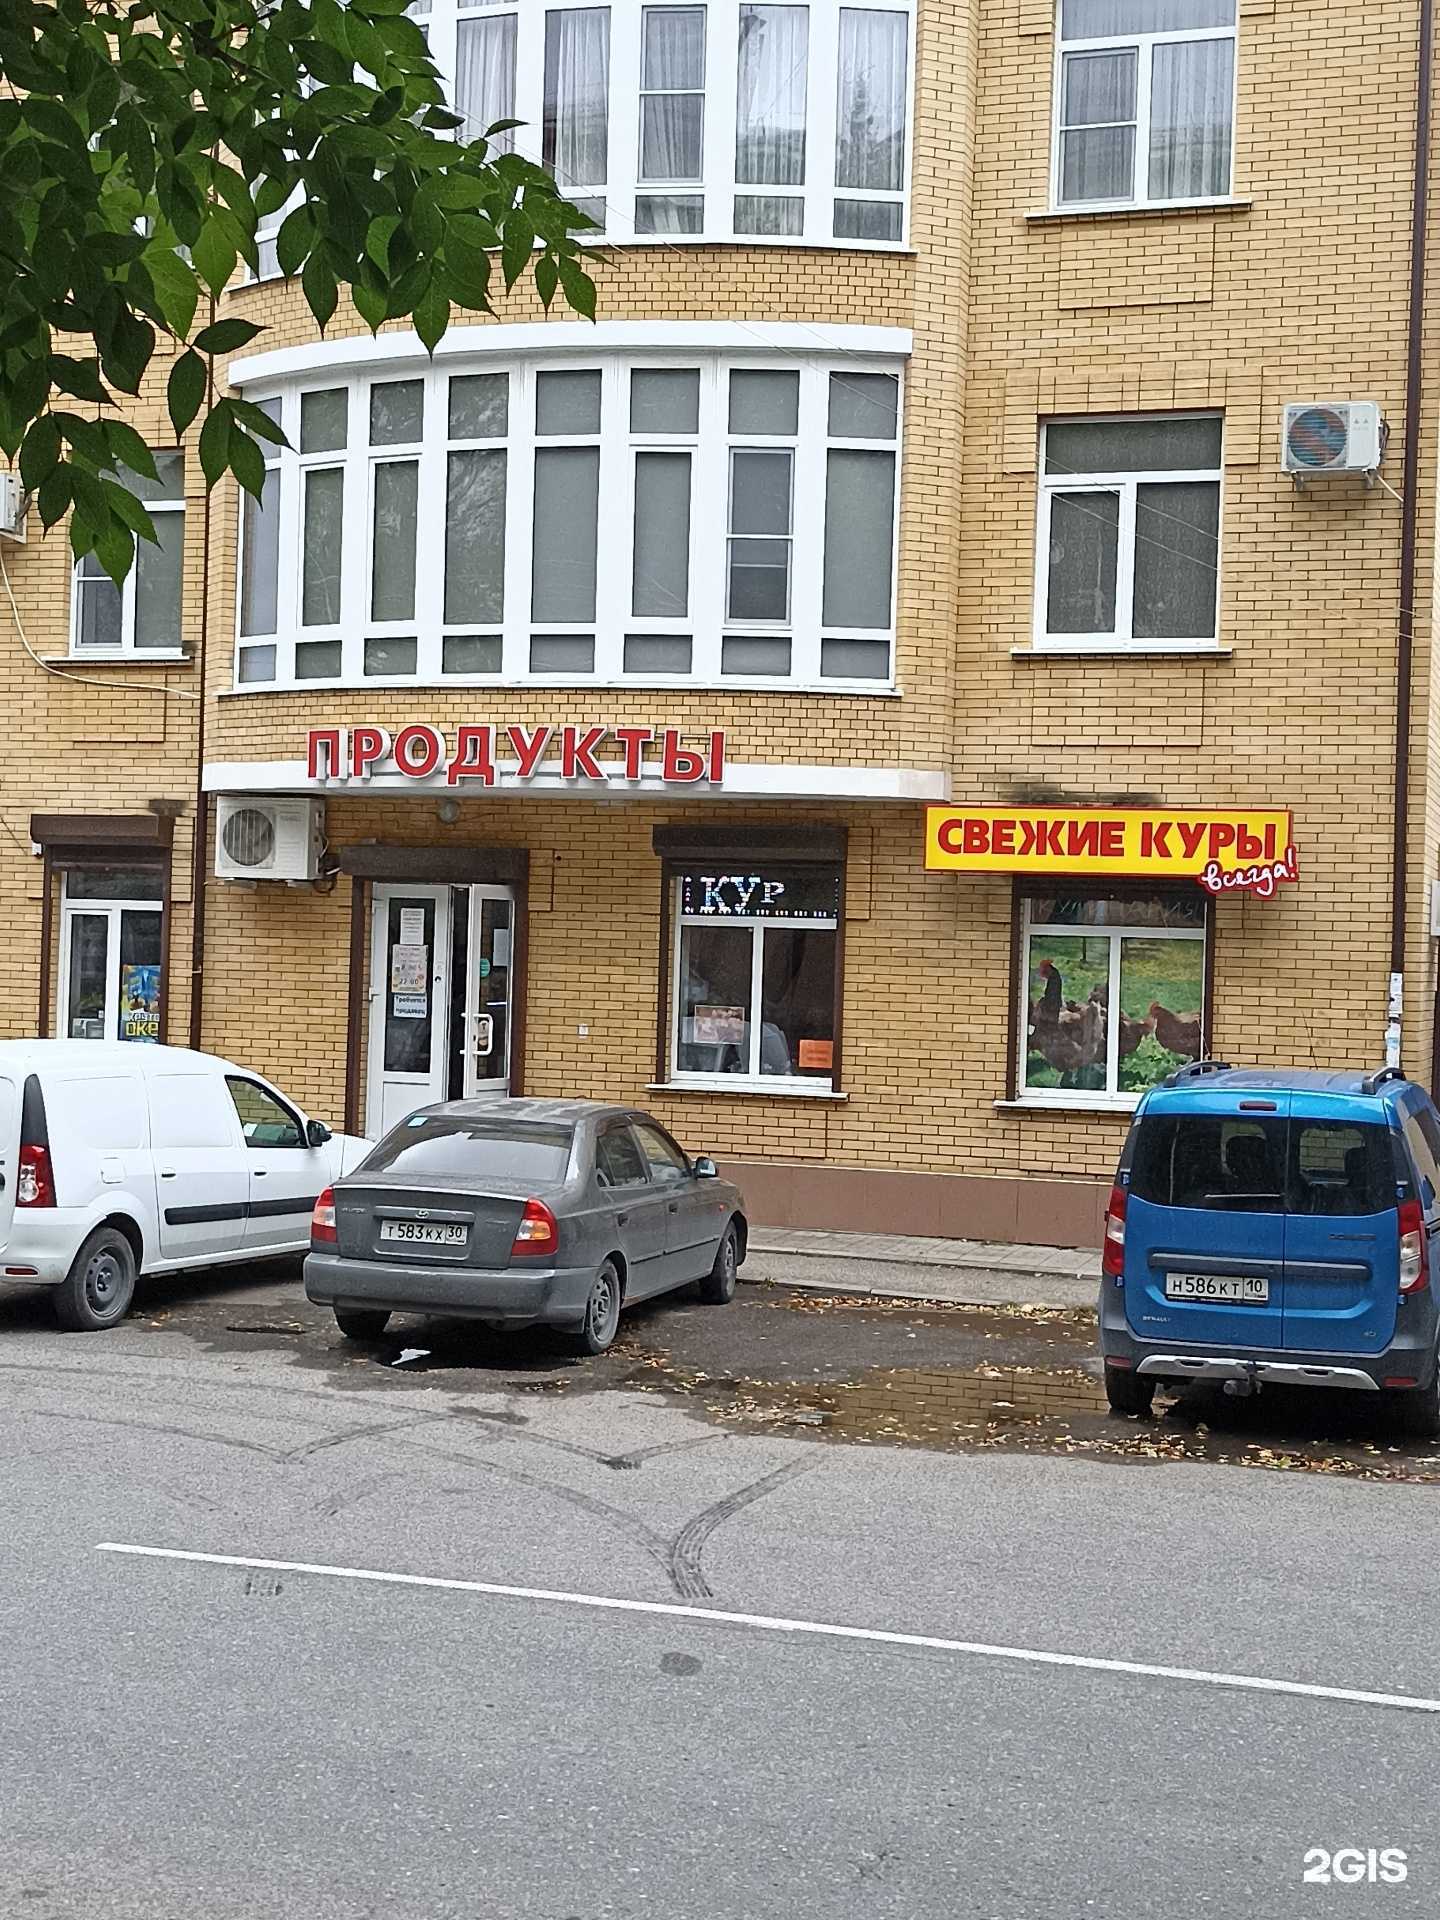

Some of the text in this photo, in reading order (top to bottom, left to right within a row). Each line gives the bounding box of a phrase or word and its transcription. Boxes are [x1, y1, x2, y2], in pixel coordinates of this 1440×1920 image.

[307, 725, 726, 787] ПРОДУКТЫ
[937, 819, 1277, 860] СВЕЖИЕ КУРЫ
[1201, 848, 1297, 896] всегда!
